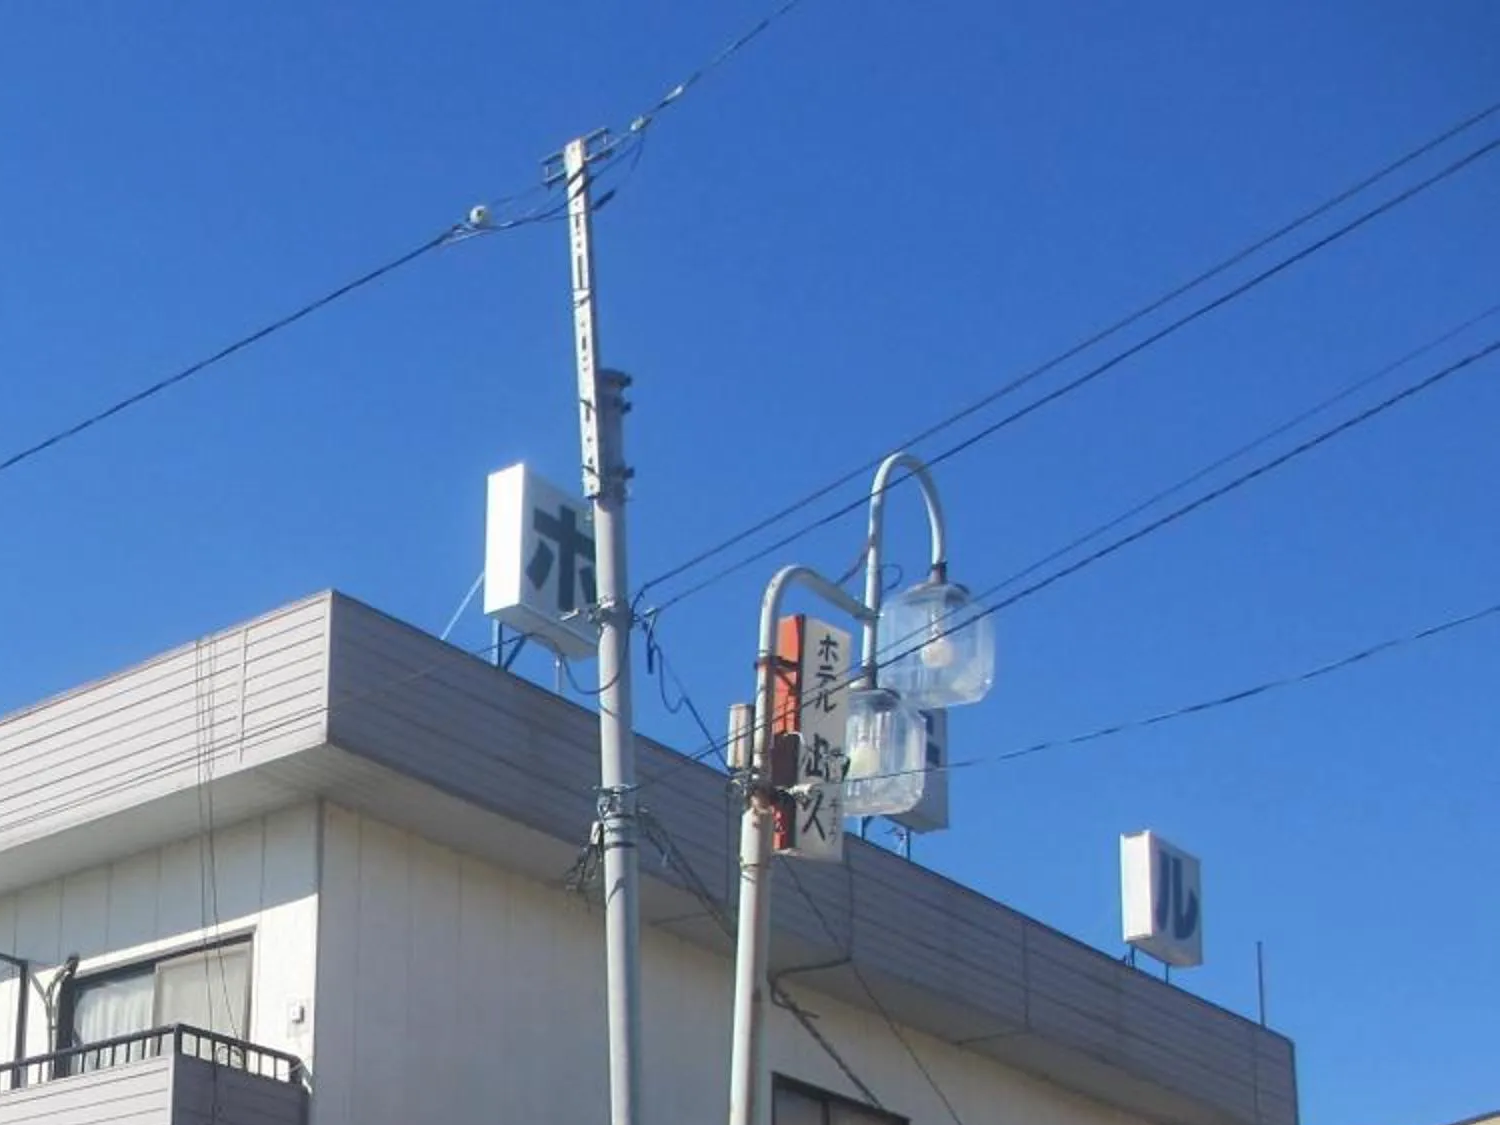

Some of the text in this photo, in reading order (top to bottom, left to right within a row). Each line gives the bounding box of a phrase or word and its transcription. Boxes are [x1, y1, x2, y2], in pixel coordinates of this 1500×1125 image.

[816, 633, 840, 713] ホテル
[1155, 849, 1199, 940] ル
